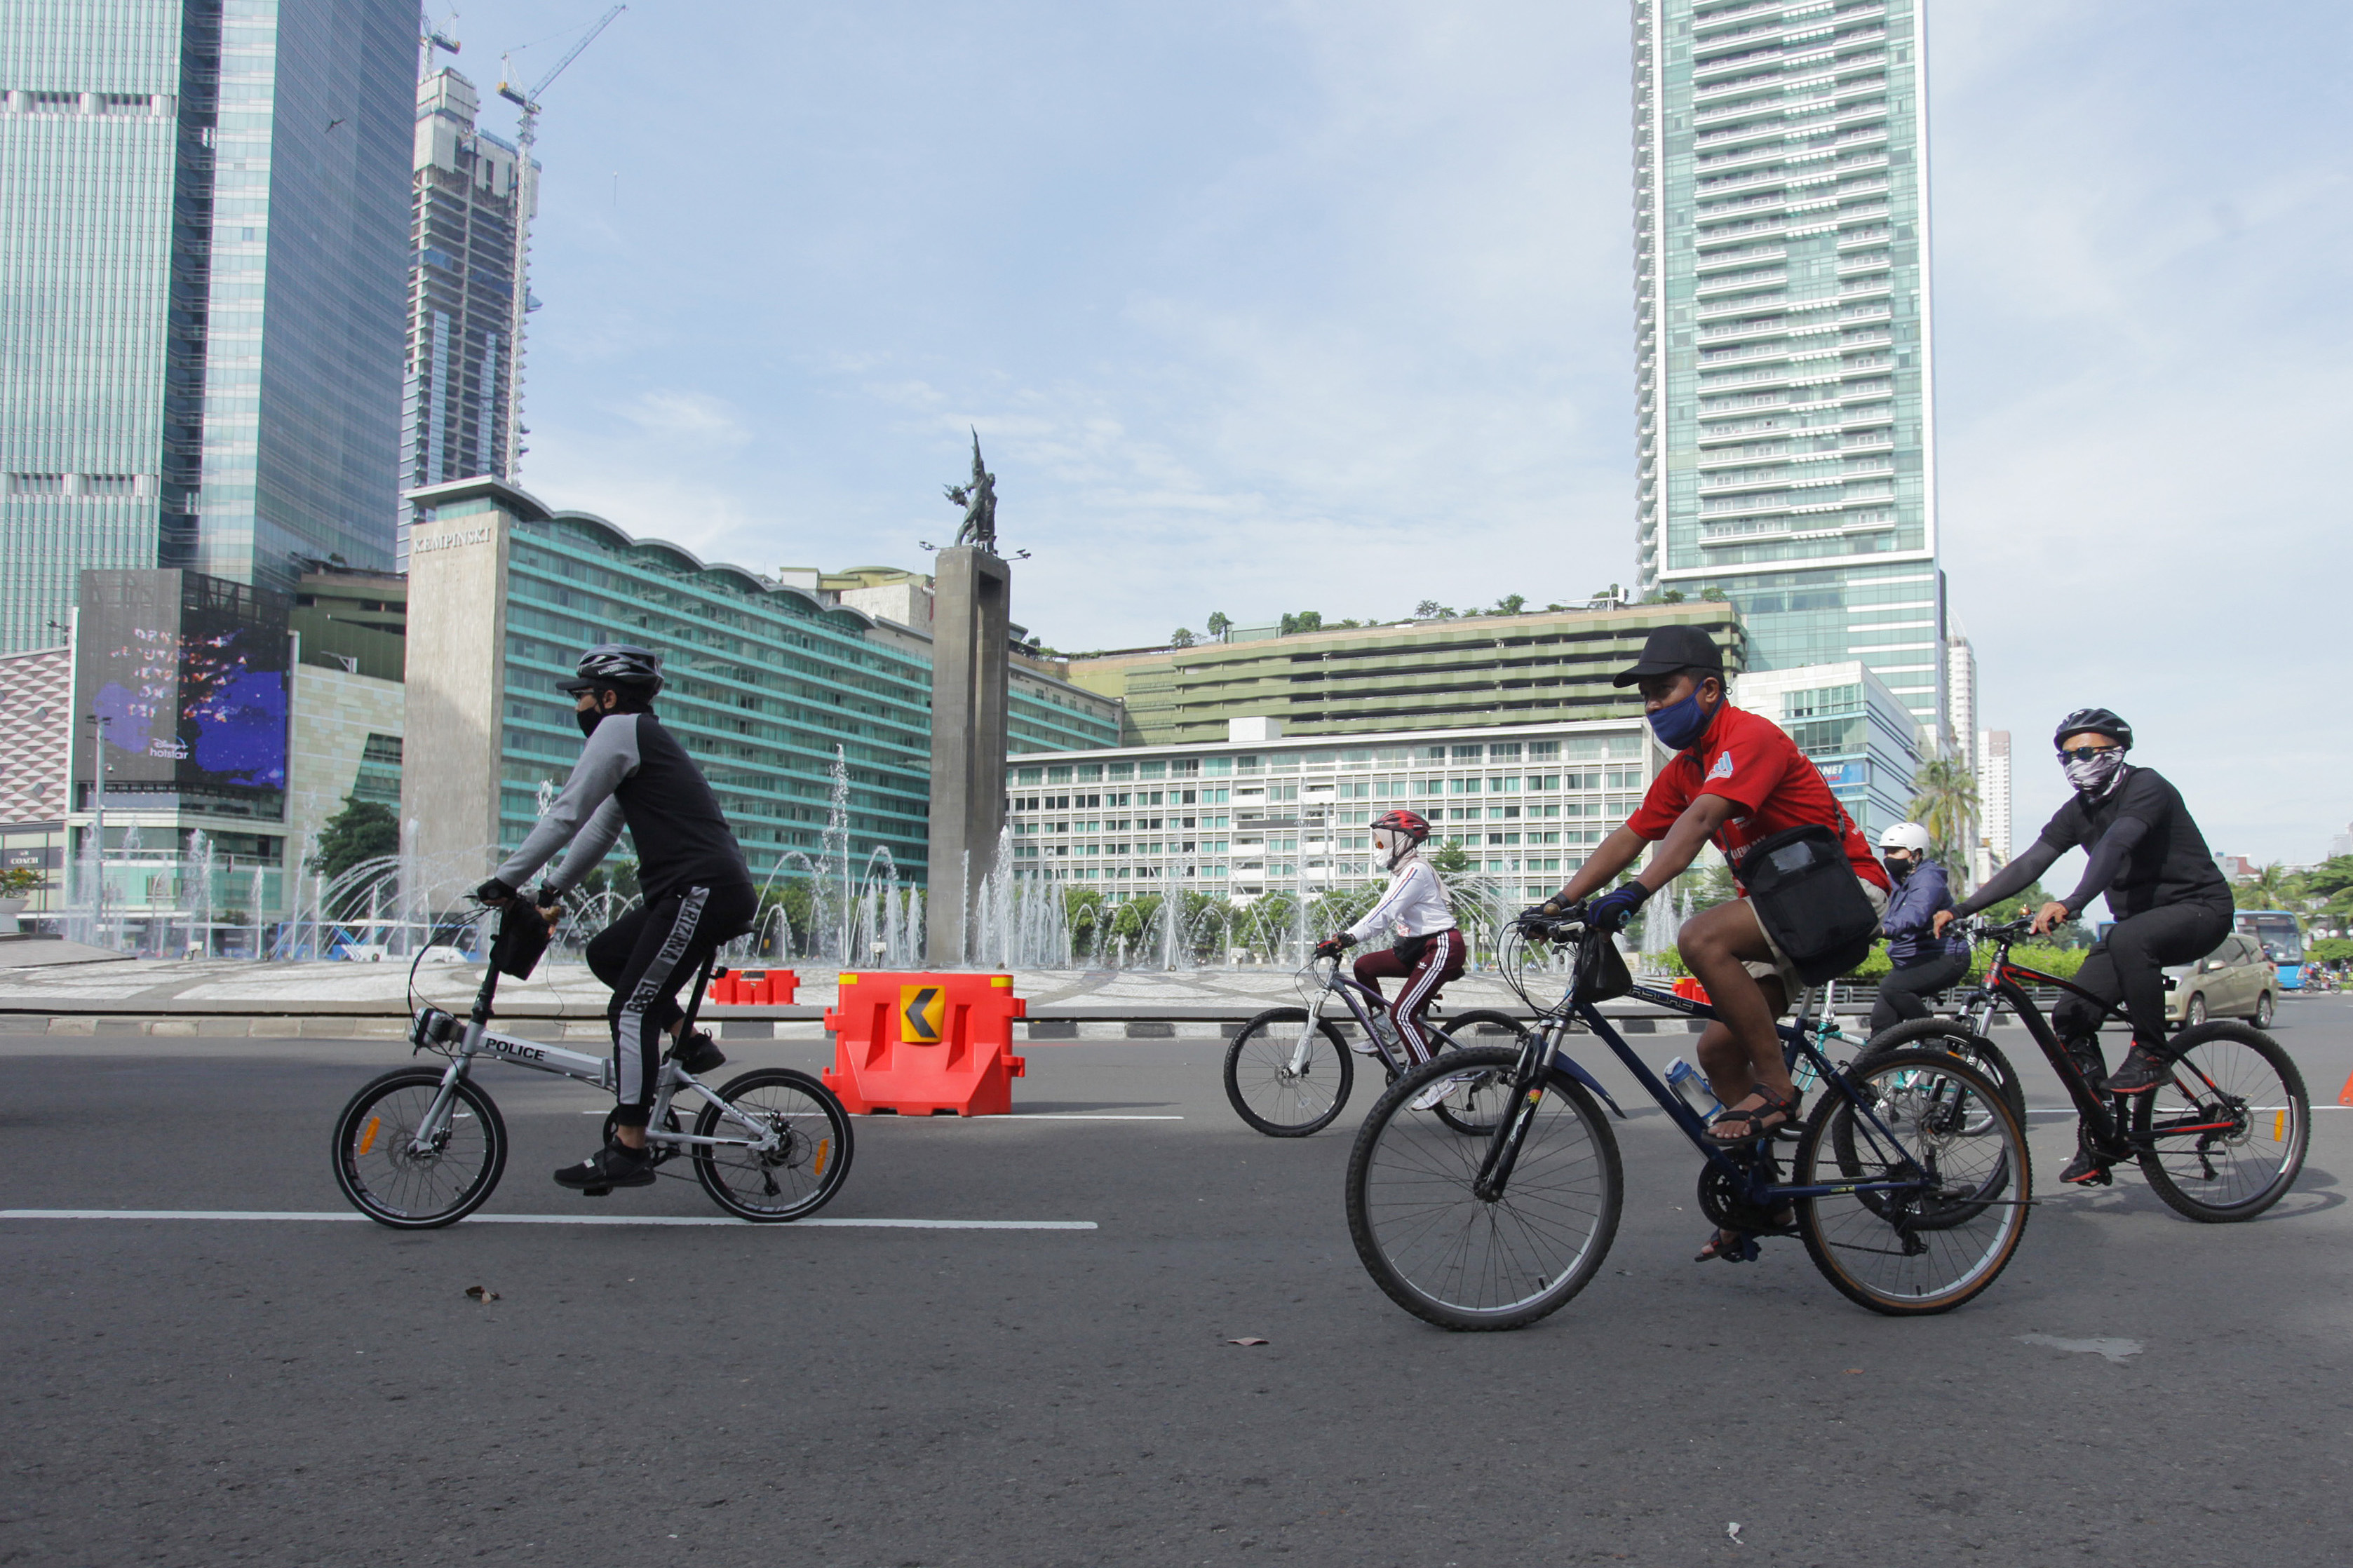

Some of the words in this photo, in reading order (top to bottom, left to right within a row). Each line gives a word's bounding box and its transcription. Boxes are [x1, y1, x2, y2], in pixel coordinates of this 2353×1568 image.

[414, 527, 490, 554] KEMPINSKI
[149, 748, 189, 759] hotstar
[660, 898, 702, 960] ARIZONA
[485, 1038, 546, 1062] POLICE
